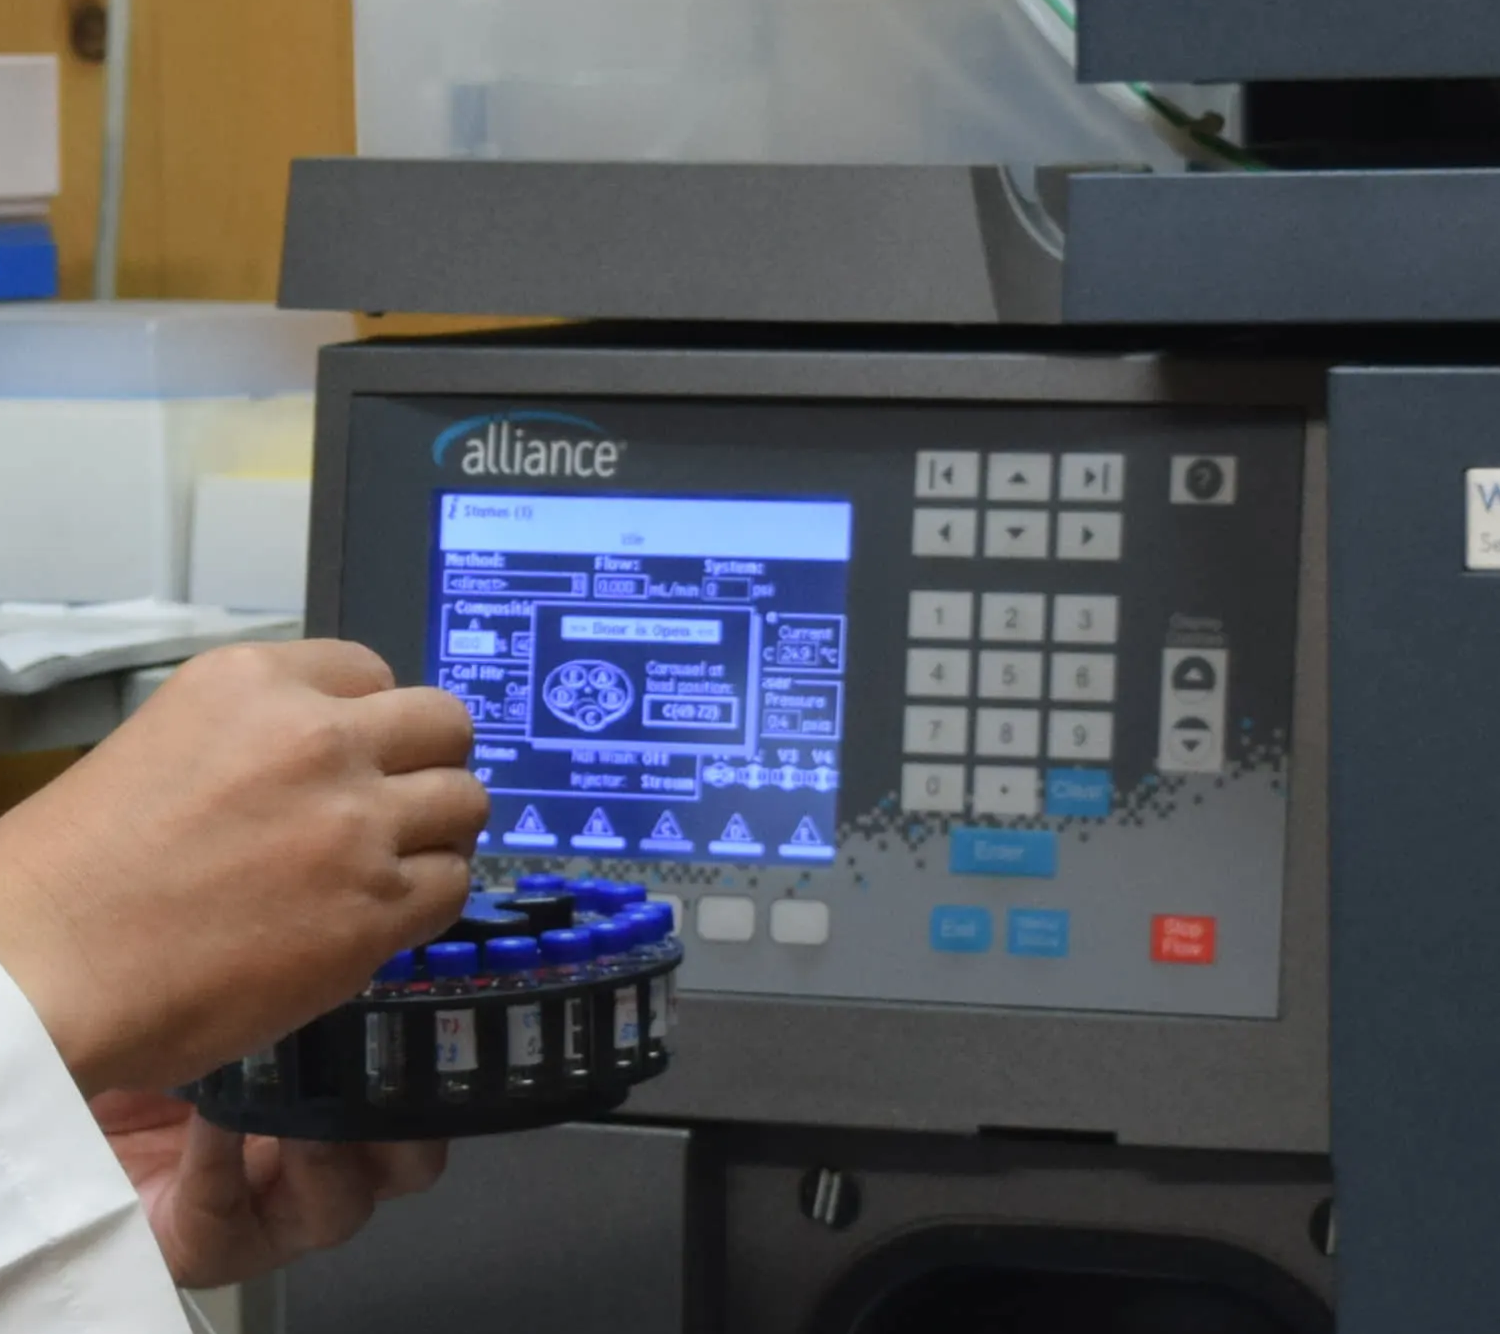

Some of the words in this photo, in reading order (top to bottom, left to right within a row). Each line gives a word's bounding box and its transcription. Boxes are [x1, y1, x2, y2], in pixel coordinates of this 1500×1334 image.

[461, 420, 619, 477] alliance
[934, 606, 944, 625] 1
[1004, 607, 1019, 629] 2
[1077, 608, 1092, 630] 3
[929, 663, 945, 683] 4
[1002, 664, 1017, 685] 5
[929, 720, 943, 741] 7
[999, 722, 1014, 744] 8
[1072, 724, 1087, 747] 9
[926, 776, 940, 796] 0
